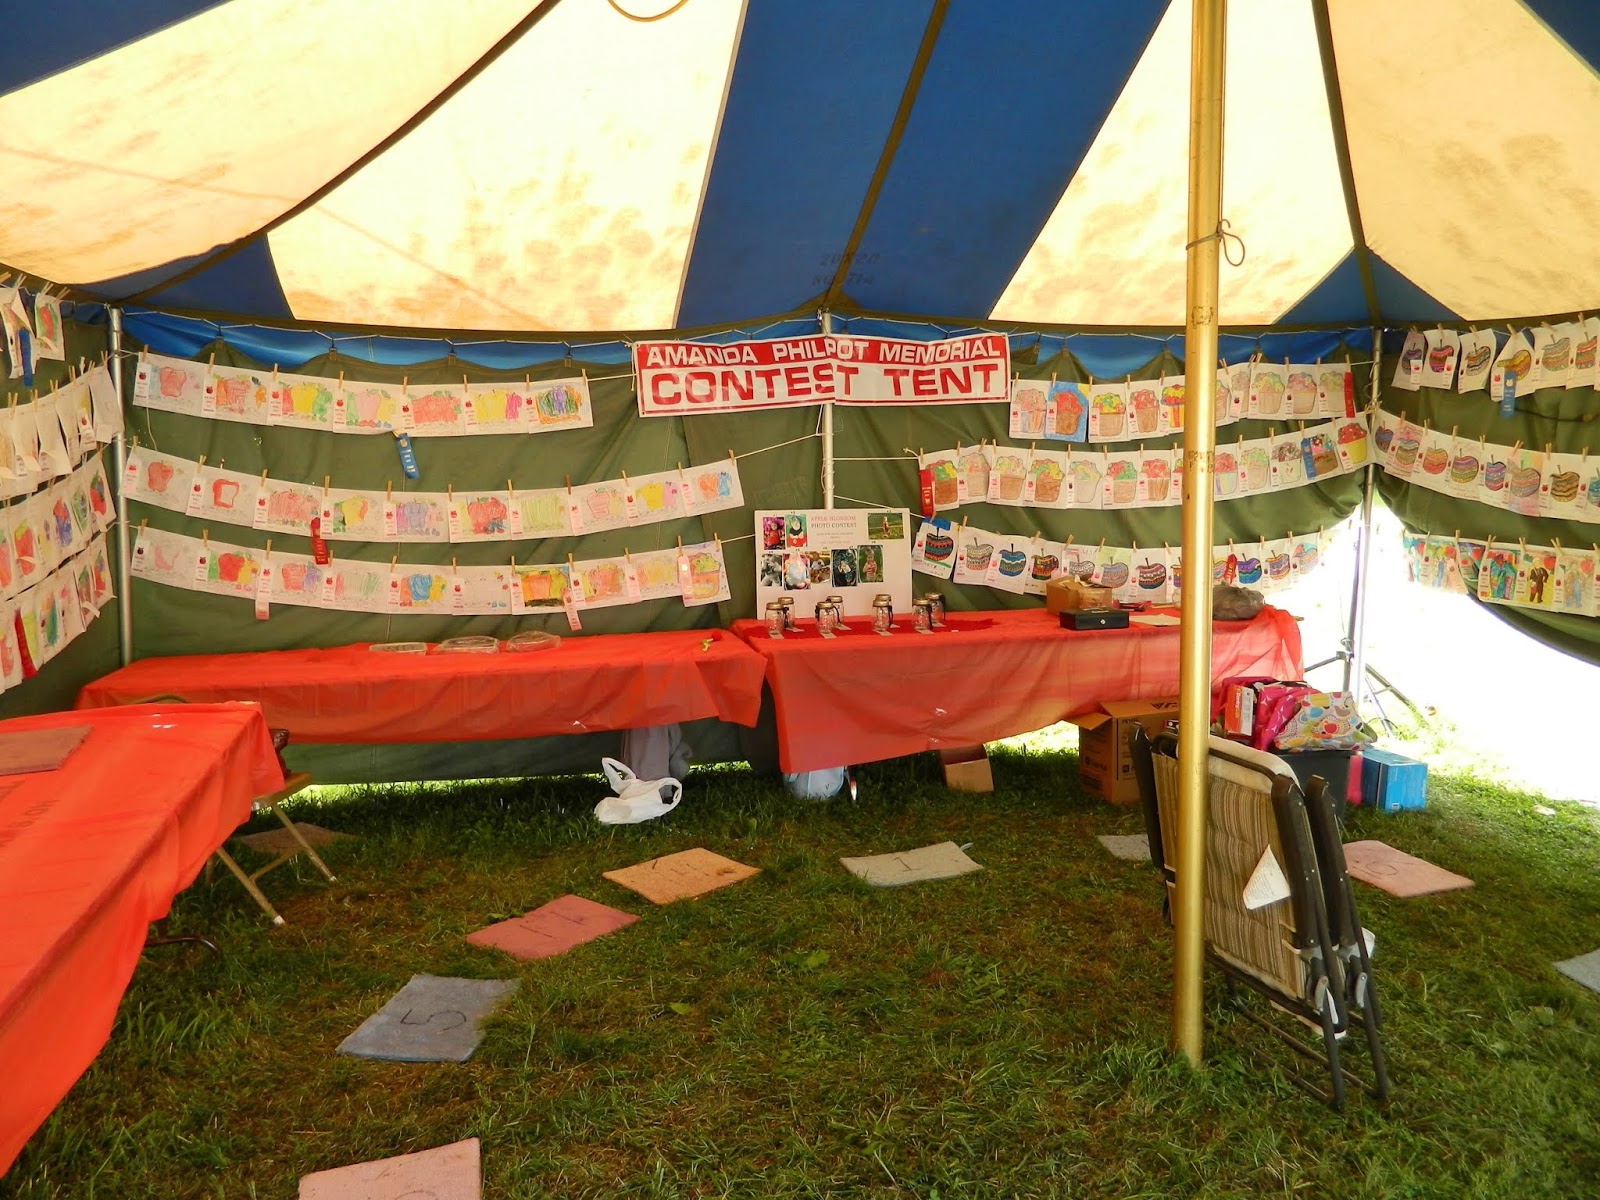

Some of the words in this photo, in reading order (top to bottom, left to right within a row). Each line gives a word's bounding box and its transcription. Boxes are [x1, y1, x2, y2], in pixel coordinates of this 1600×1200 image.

[647, 346, 757, 366] AMANDA
[772, 342, 869, 363] PHILPOT
[879, 339, 1001, 364] MEMORIAL
[651, 364, 858, 404] CONTEST
[883, 363, 998, 396] TENT
[400, 1008, 467, 1034] 5
